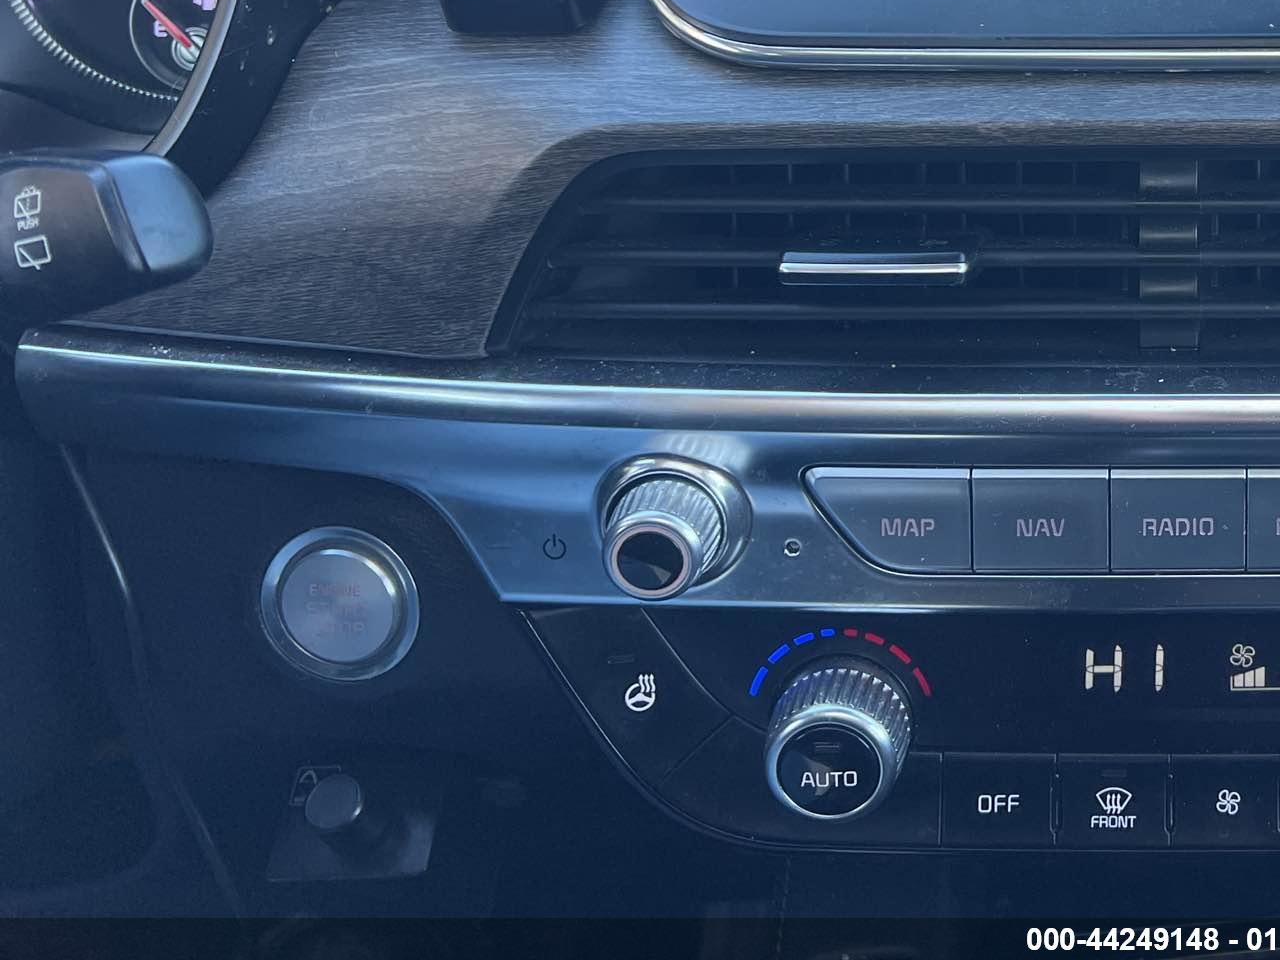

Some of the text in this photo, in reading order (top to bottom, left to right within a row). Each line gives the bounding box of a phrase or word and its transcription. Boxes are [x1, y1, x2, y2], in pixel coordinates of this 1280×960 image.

[17, 217, 39, 231] PUSH
[880, 517, 936, 537] MAP
[1015, 517, 1066, 537] NAV
[1142, 516, 1215, 537] RADIO
[800, 770, 858, 788] AUTO
[977, 794, 1020, 813] OFF
[1090, 815, 1137, 829] FRONT
